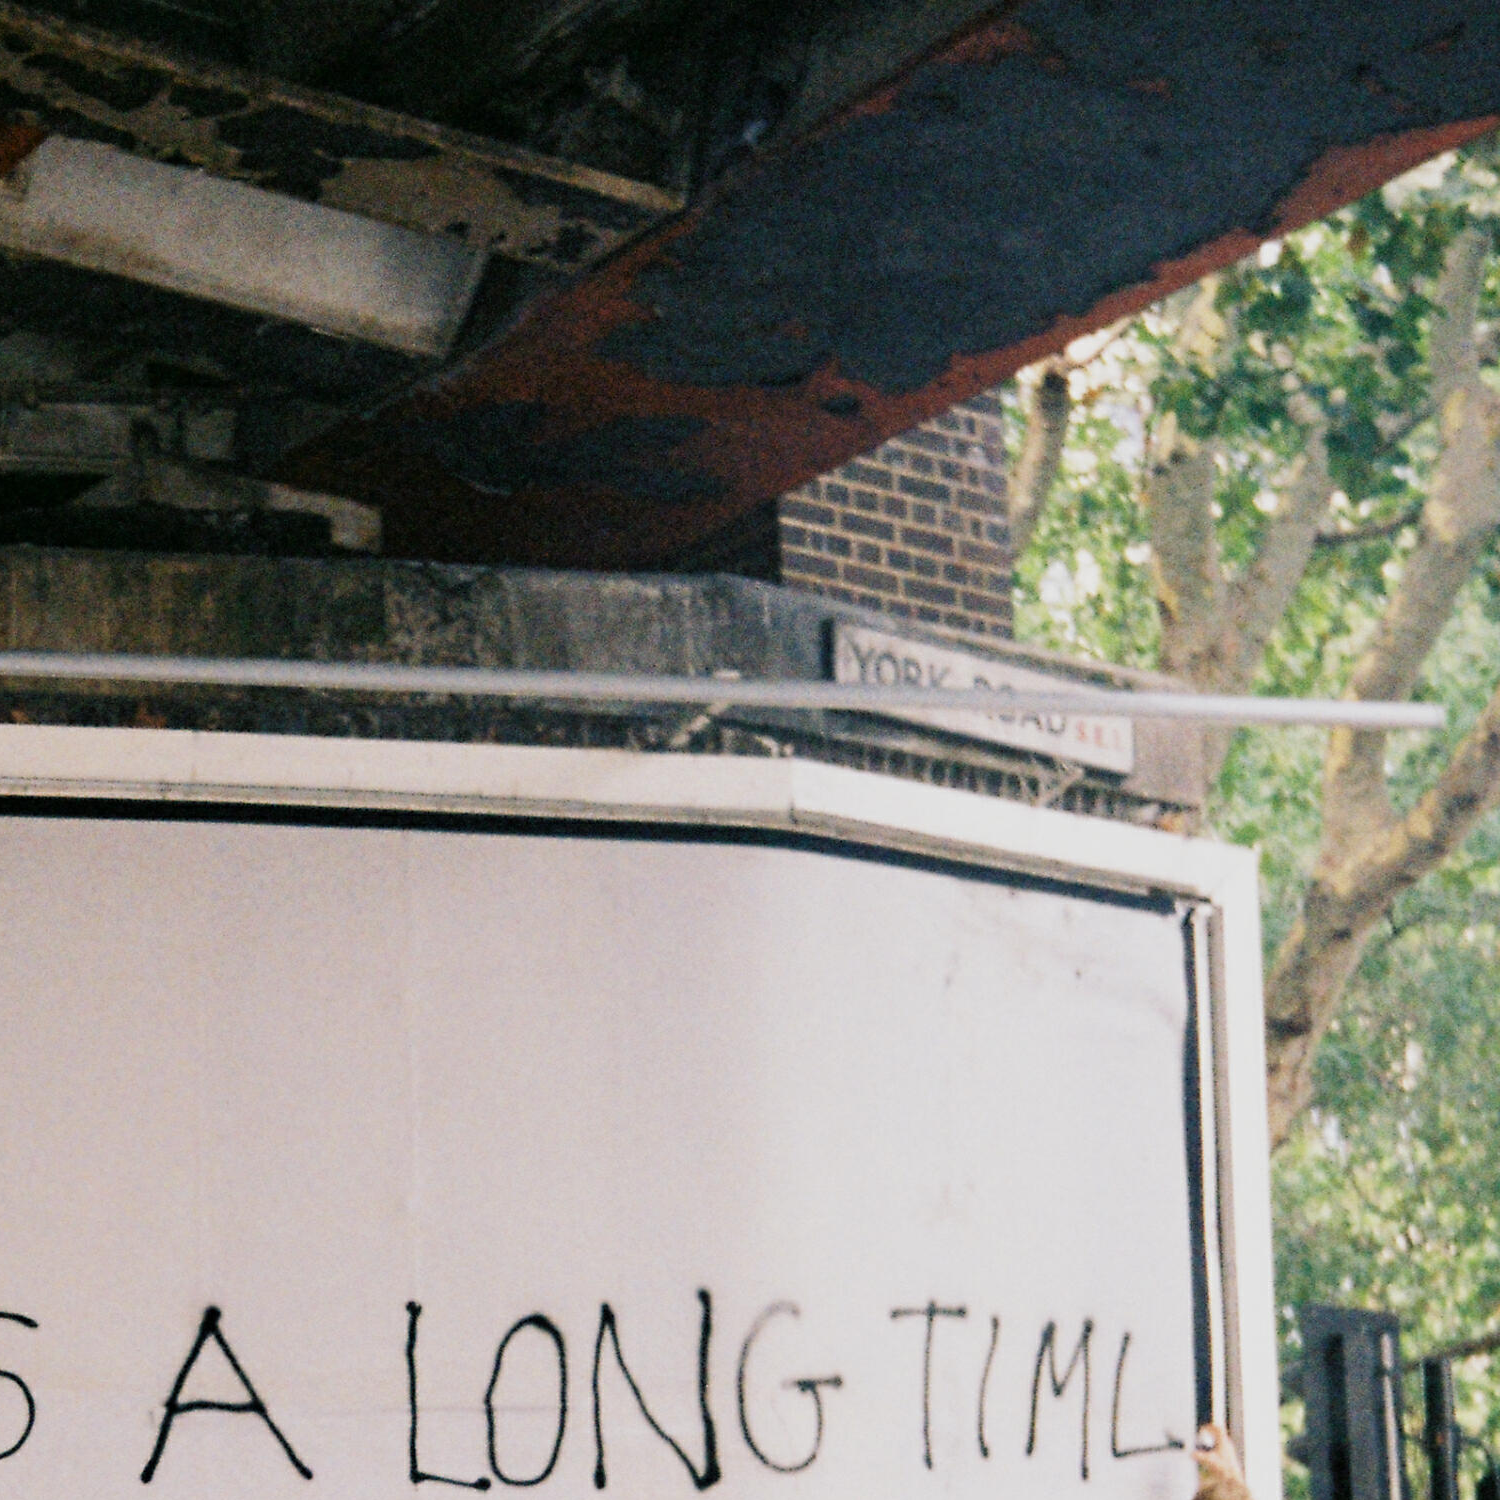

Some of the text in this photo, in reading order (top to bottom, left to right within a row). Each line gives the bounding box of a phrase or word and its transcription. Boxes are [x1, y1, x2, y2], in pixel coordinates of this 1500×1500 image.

[843, 634, 952, 689] YORK
[140, 1305, 314, 1483] A
[406, 1287, 843, 1491] LONG
